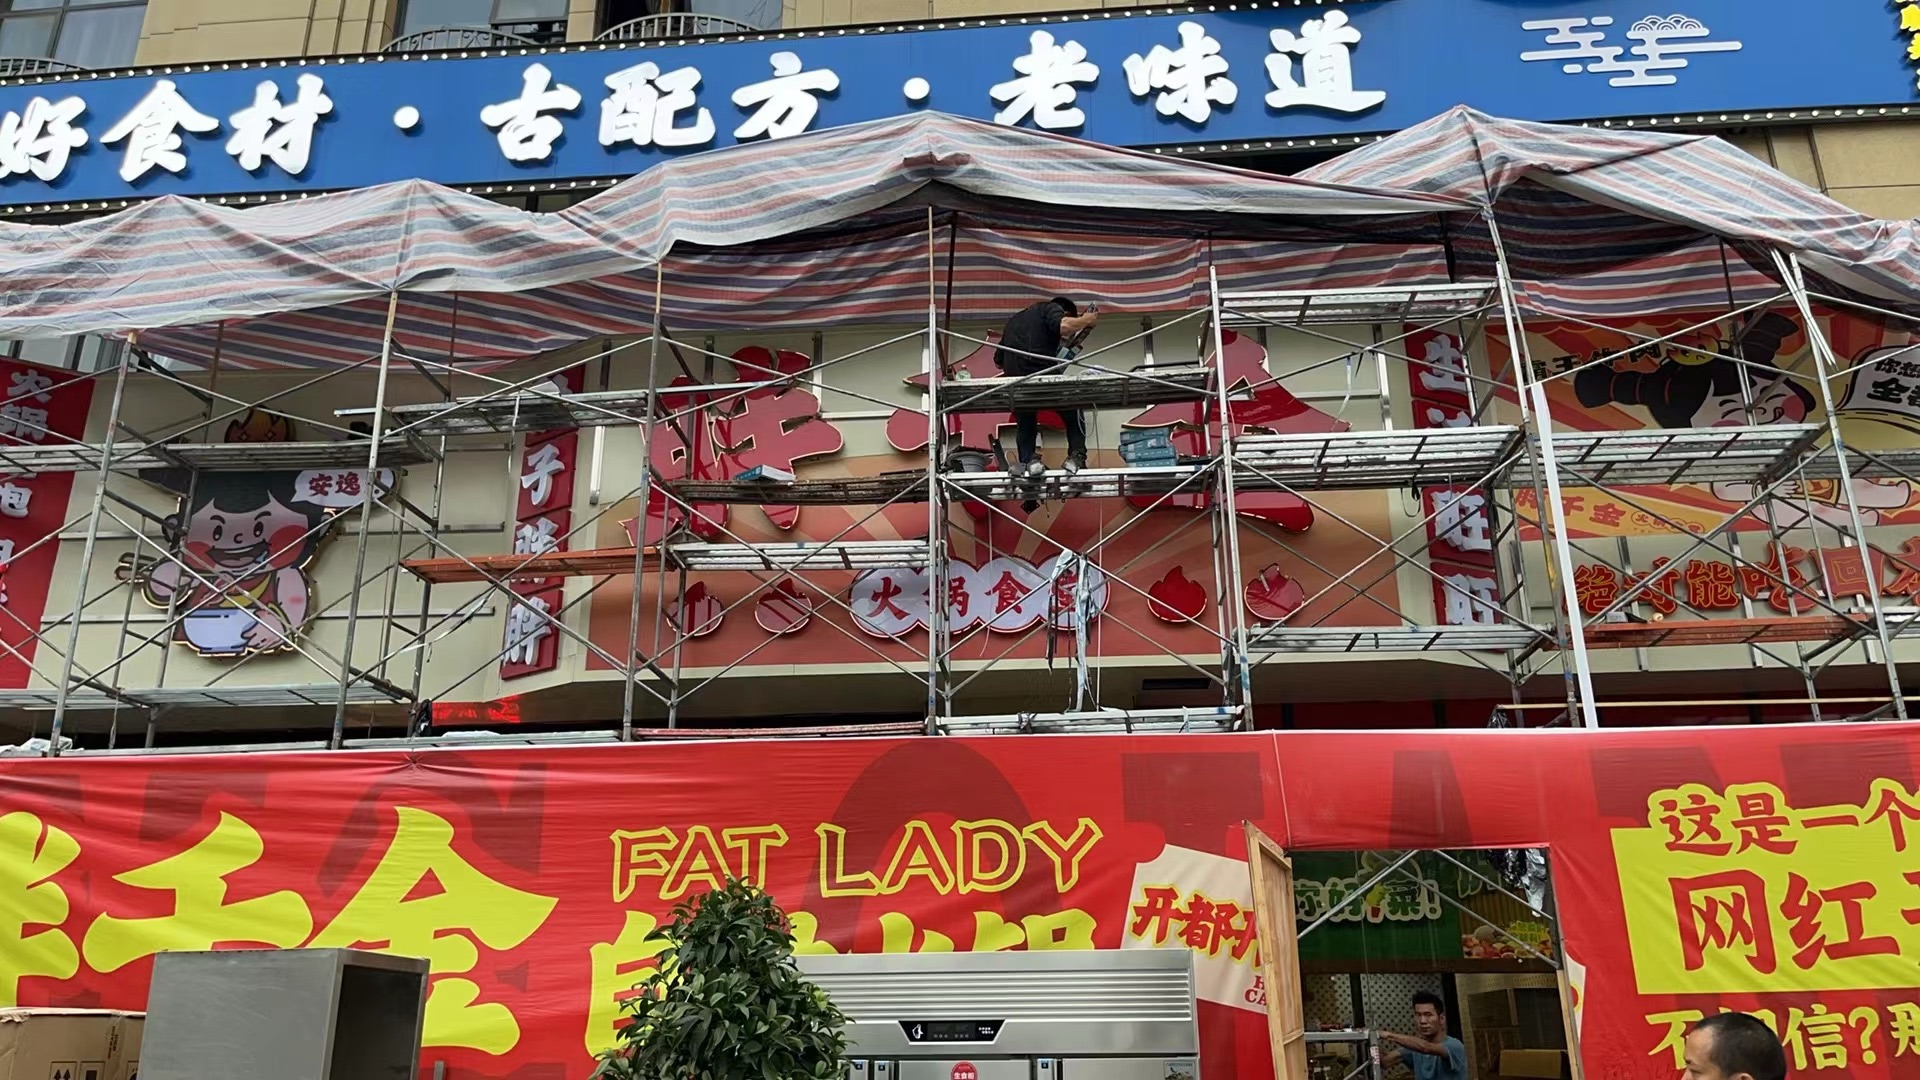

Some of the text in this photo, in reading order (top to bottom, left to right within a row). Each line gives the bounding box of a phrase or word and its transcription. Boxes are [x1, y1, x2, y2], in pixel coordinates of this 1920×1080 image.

[609, 817, 1104, 903] FAT LADY
[1668, 869, 1920, 975] 网红
